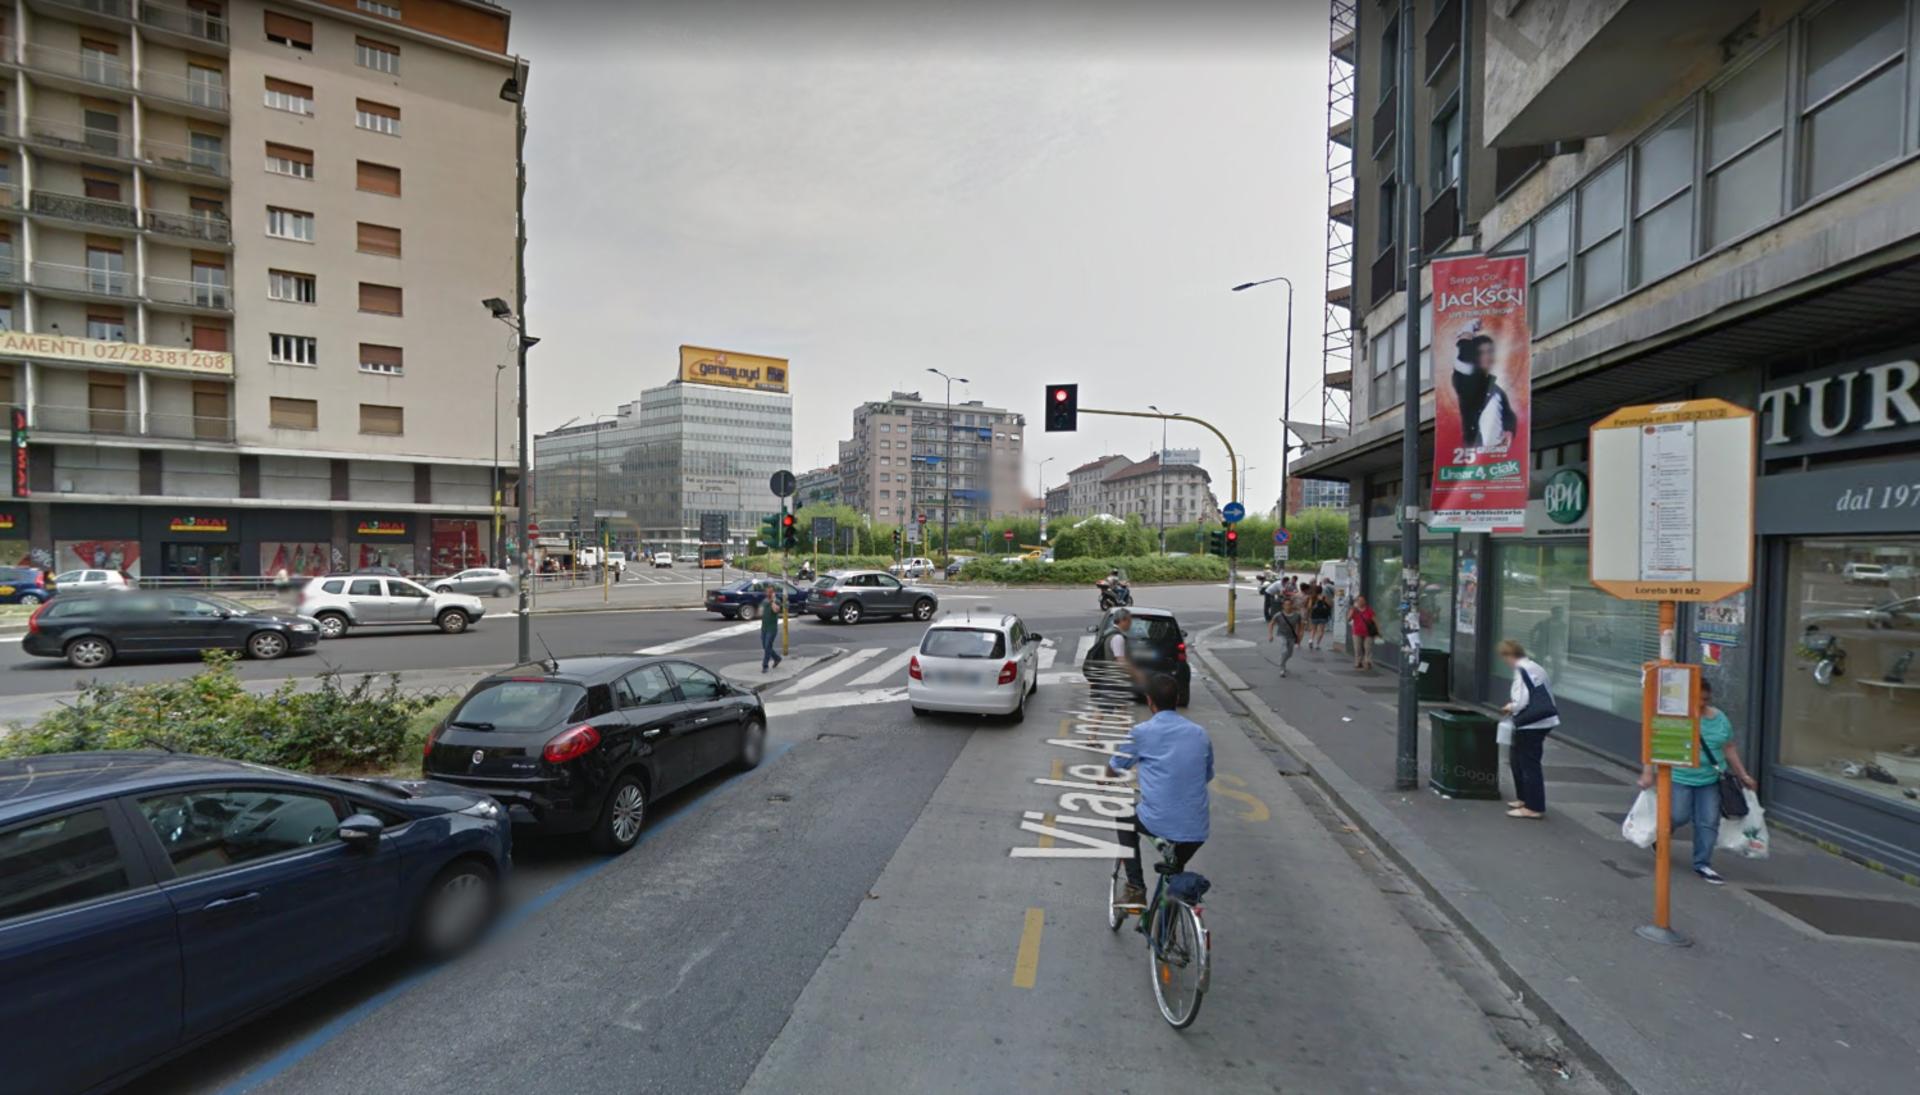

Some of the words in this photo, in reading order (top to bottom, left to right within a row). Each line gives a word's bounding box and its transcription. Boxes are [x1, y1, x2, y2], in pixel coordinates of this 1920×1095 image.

[1438, 286, 1523, 312] JACKSON
[4, 336, 85, 356] AMENTI
[94, 346, 225, 369] 02/28381208
[1760, 360, 1920, 445] TUR
[1453, 448, 1476, 464] 25
[1545, 481, 1582, 513] BPM
[1836, 489, 1873, 511] dal
[1635, 587, 1667, 595] Loreto
[1669, 587, 1682, 595] M1
